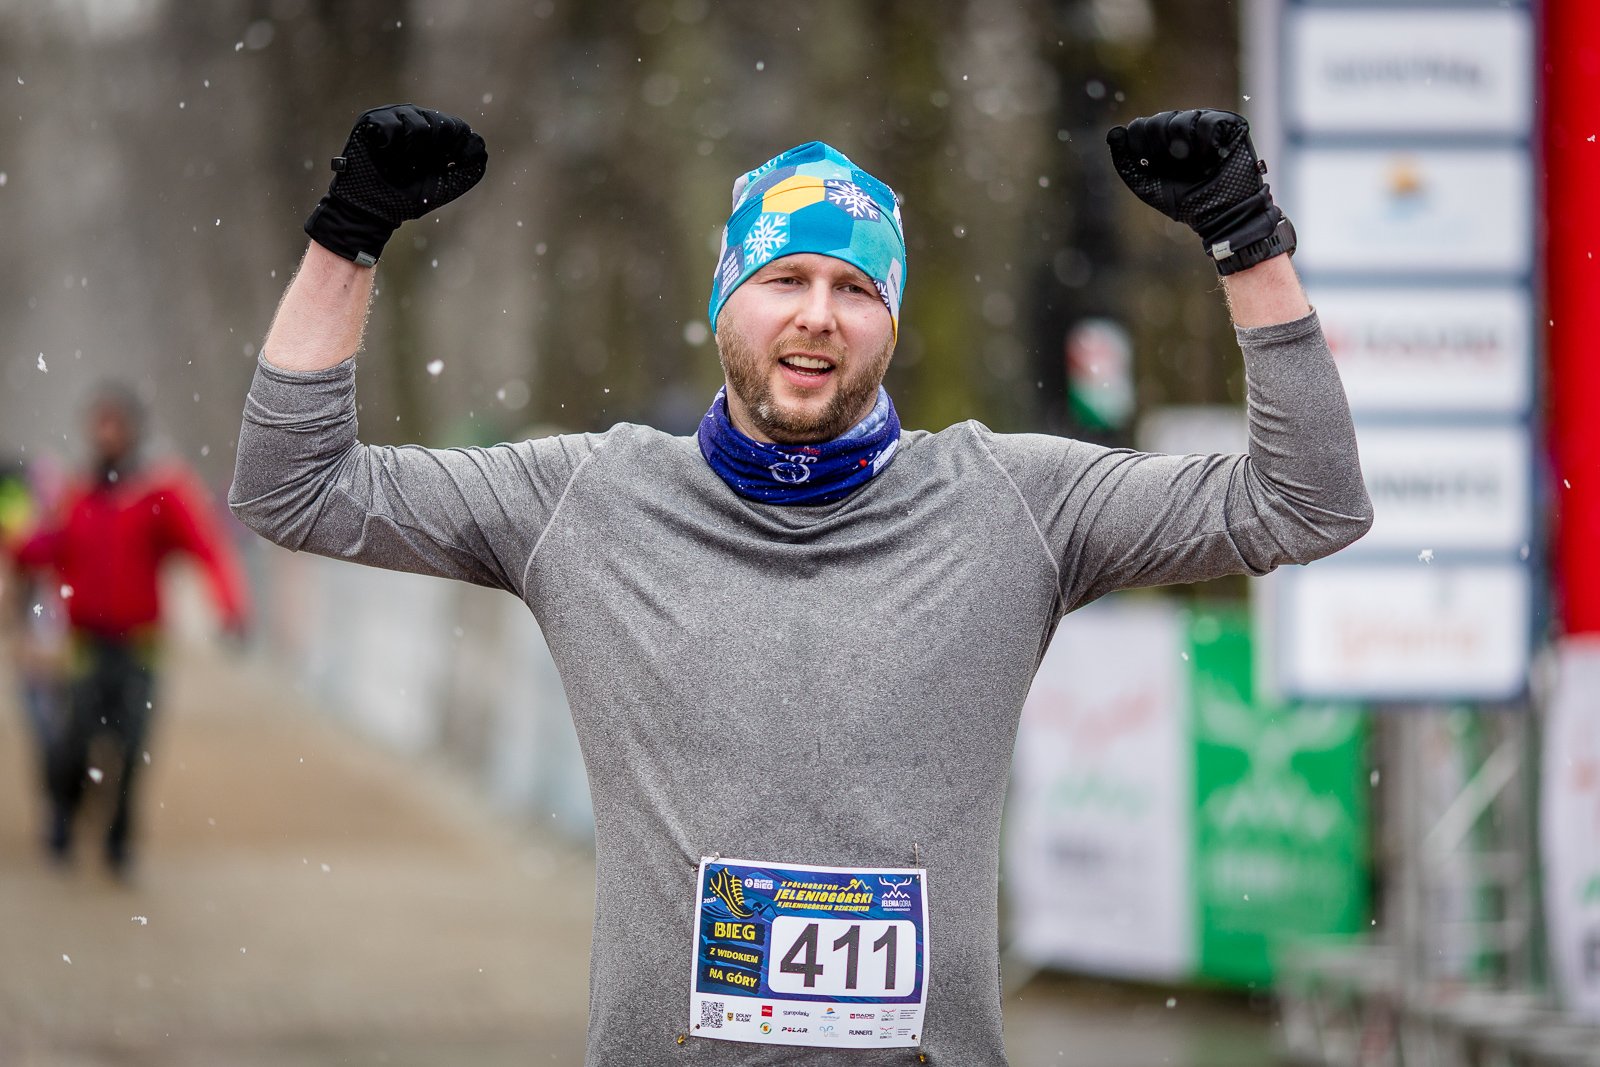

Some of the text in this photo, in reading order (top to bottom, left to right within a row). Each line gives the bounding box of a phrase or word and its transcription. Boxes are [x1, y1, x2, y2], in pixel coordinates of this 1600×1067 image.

[773, 888, 874, 904] JELENIOGÓRSKI
[714, 922, 756, 940] BIEG
[710, 947, 759, 964] Z WIDOKIEM
[780, 923, 898, 990] 411
[709, 968, 757, 987] NA GÓRY
